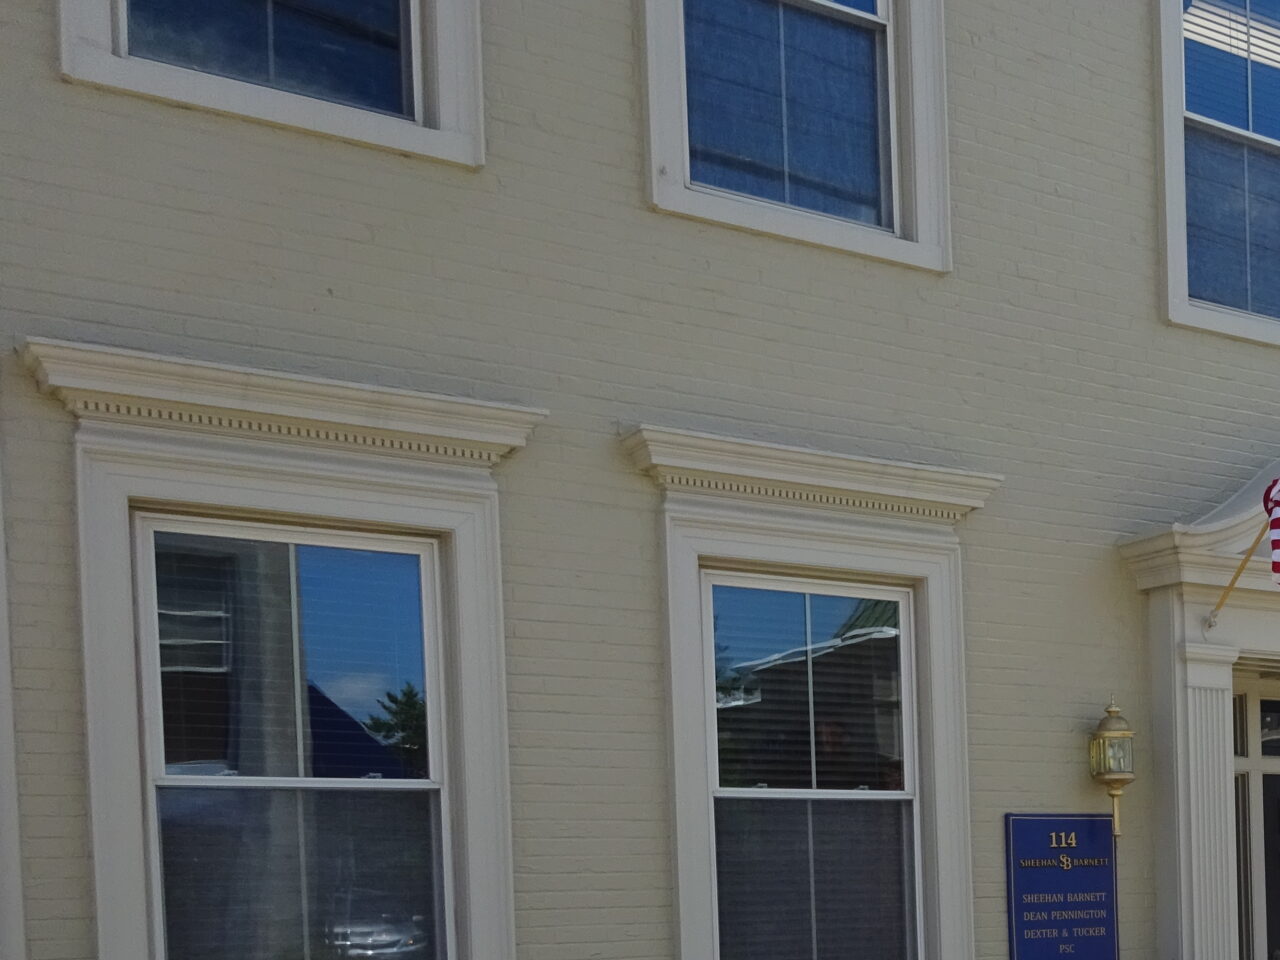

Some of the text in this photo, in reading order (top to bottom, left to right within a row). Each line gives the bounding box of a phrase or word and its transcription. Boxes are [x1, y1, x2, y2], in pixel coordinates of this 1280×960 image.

[1049, 832, 1077, 848] 114
[1020, 858, 1058, 868] SHEEHAN
[1073, 858, 1109, 867] BARNETT
[1022, 892, 1106, 903] SHEEHAN BARNETT
[1023, 909, 1107, 921] DEAN PENNINGTON
[1024, 926, 1106, 939] DEXTER & TUCKER
[1059, 944, 1075, 953] PSC
